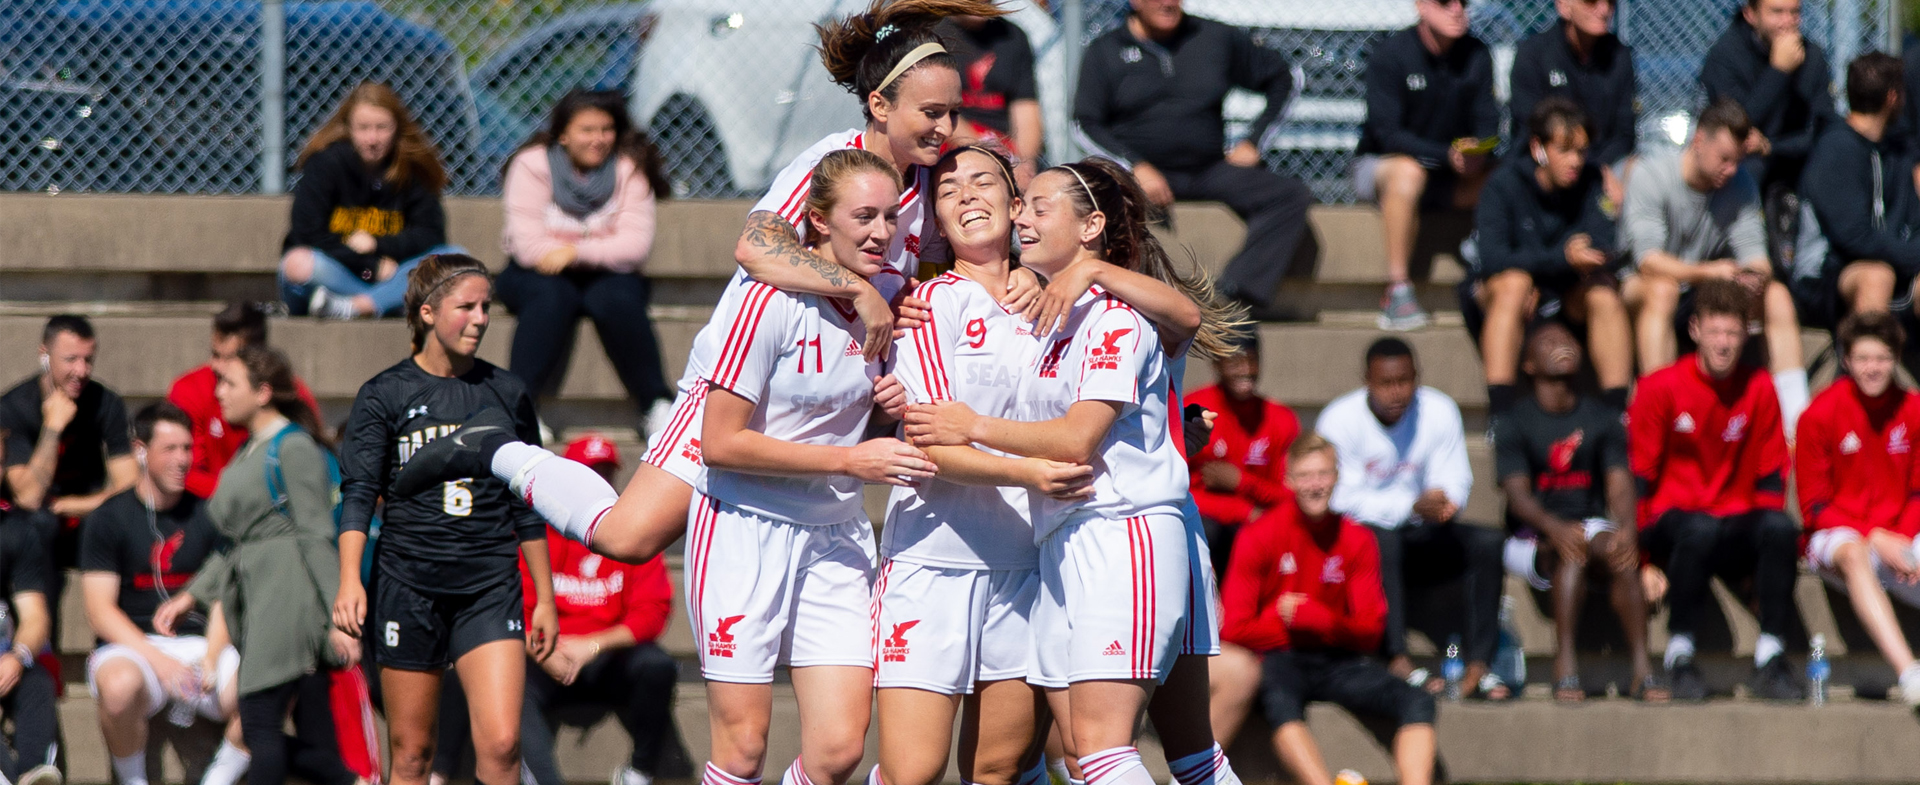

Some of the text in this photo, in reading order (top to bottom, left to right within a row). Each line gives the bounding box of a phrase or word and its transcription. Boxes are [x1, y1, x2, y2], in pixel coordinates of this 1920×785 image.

[966, 317, 987, 349] 9
[796, 333, 823, 374] 11
[789, 389, 872, 415] SEA-HA
[443, 477, 473, 516] 6
[385, 620, 400, 647] 6
